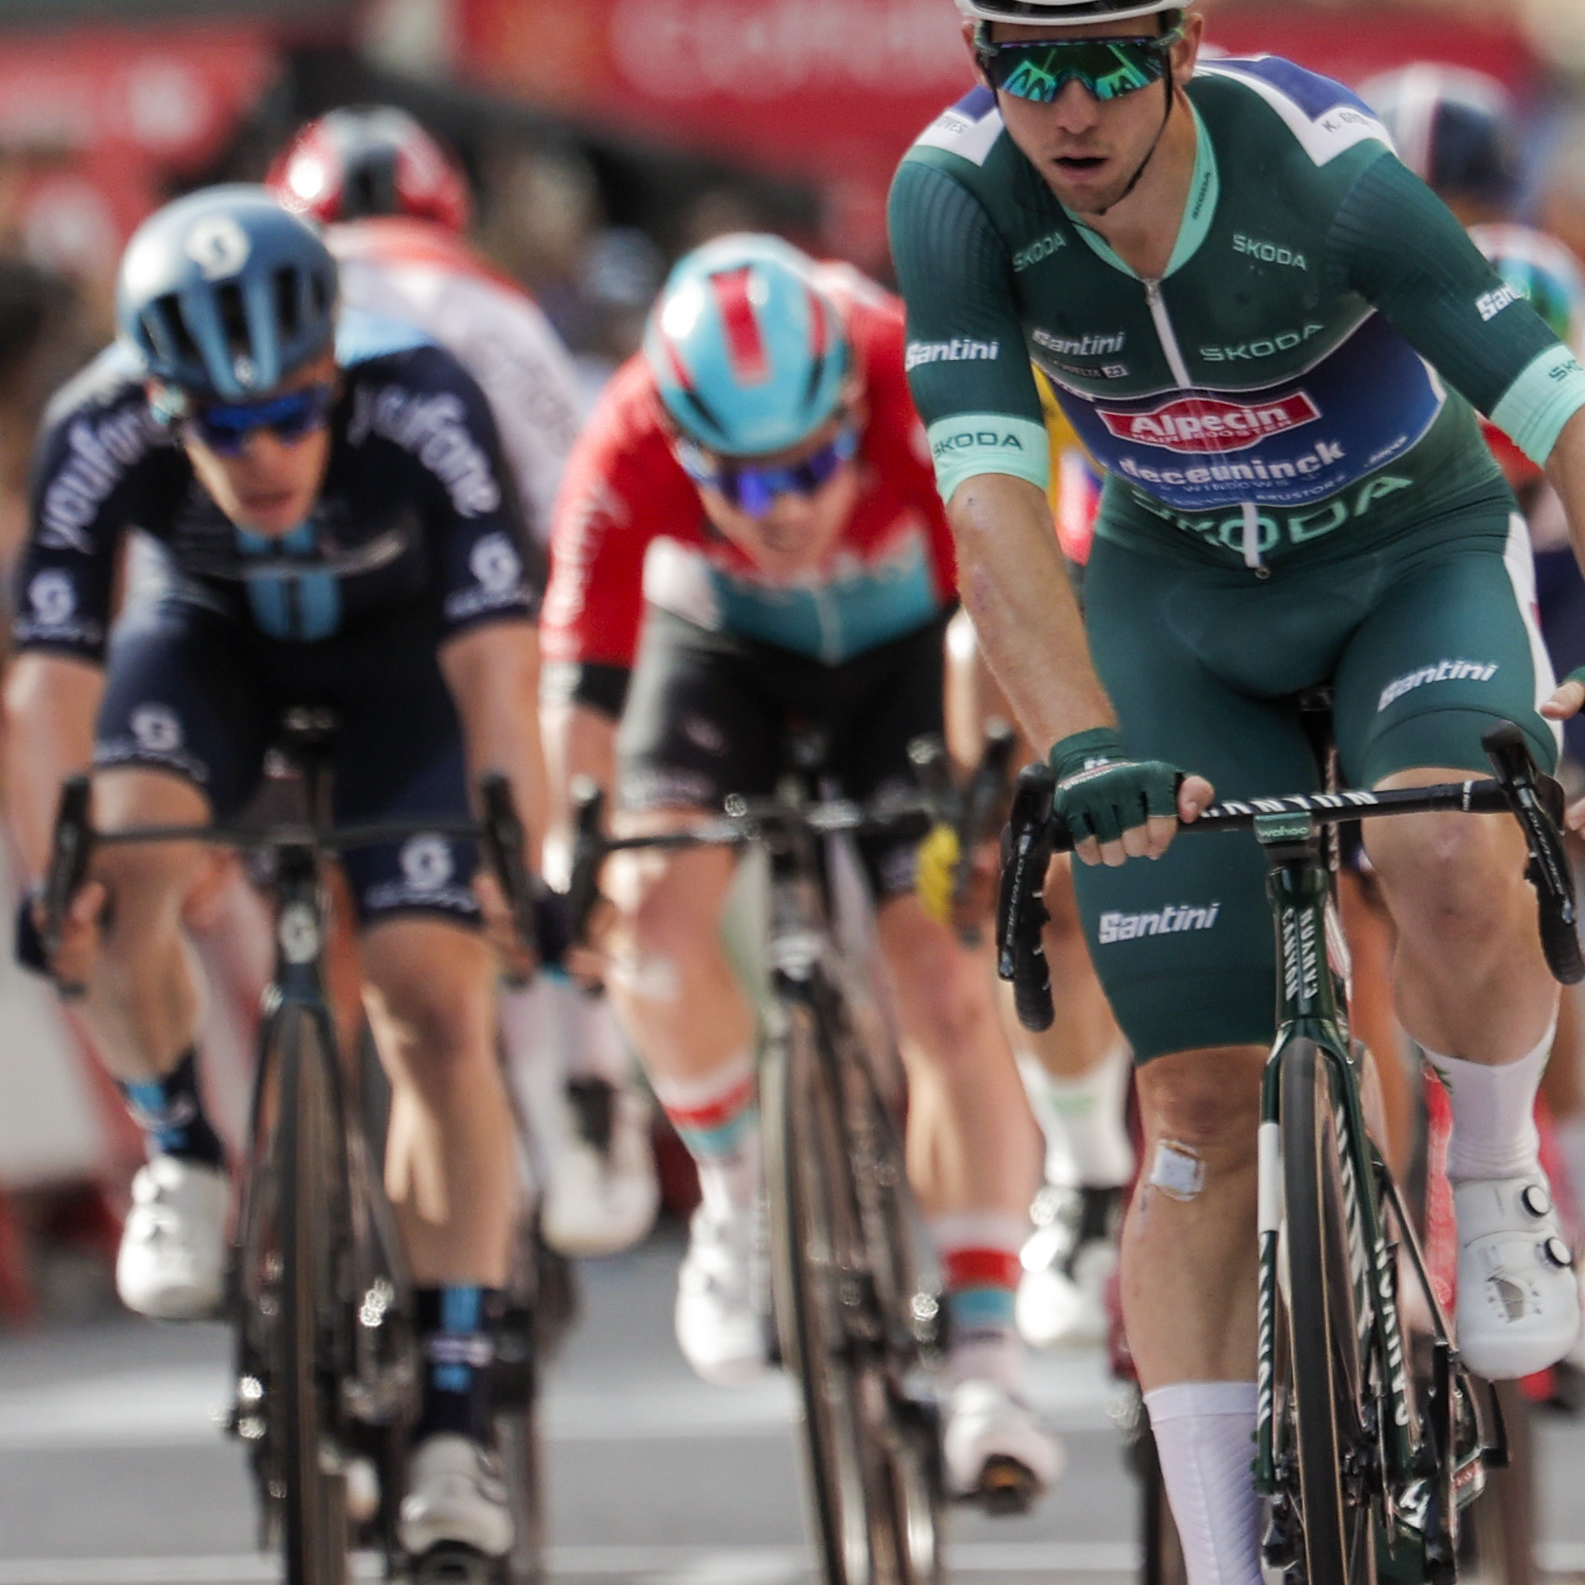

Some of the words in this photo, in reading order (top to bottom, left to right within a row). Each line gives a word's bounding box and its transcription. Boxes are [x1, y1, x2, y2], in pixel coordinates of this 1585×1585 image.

[904, 339, 1000, 372] Santini
[1031, 329, 1126, 356] Santini
[1131, 407, 1289, 440] Alpecin
[1118, 439, 1345, 488] deceuninck
[1377, 658, 1499, 712] Santini
[1258, 825, 1310, 838] wahoo
[1099, 902, 1220, 945] Santini
